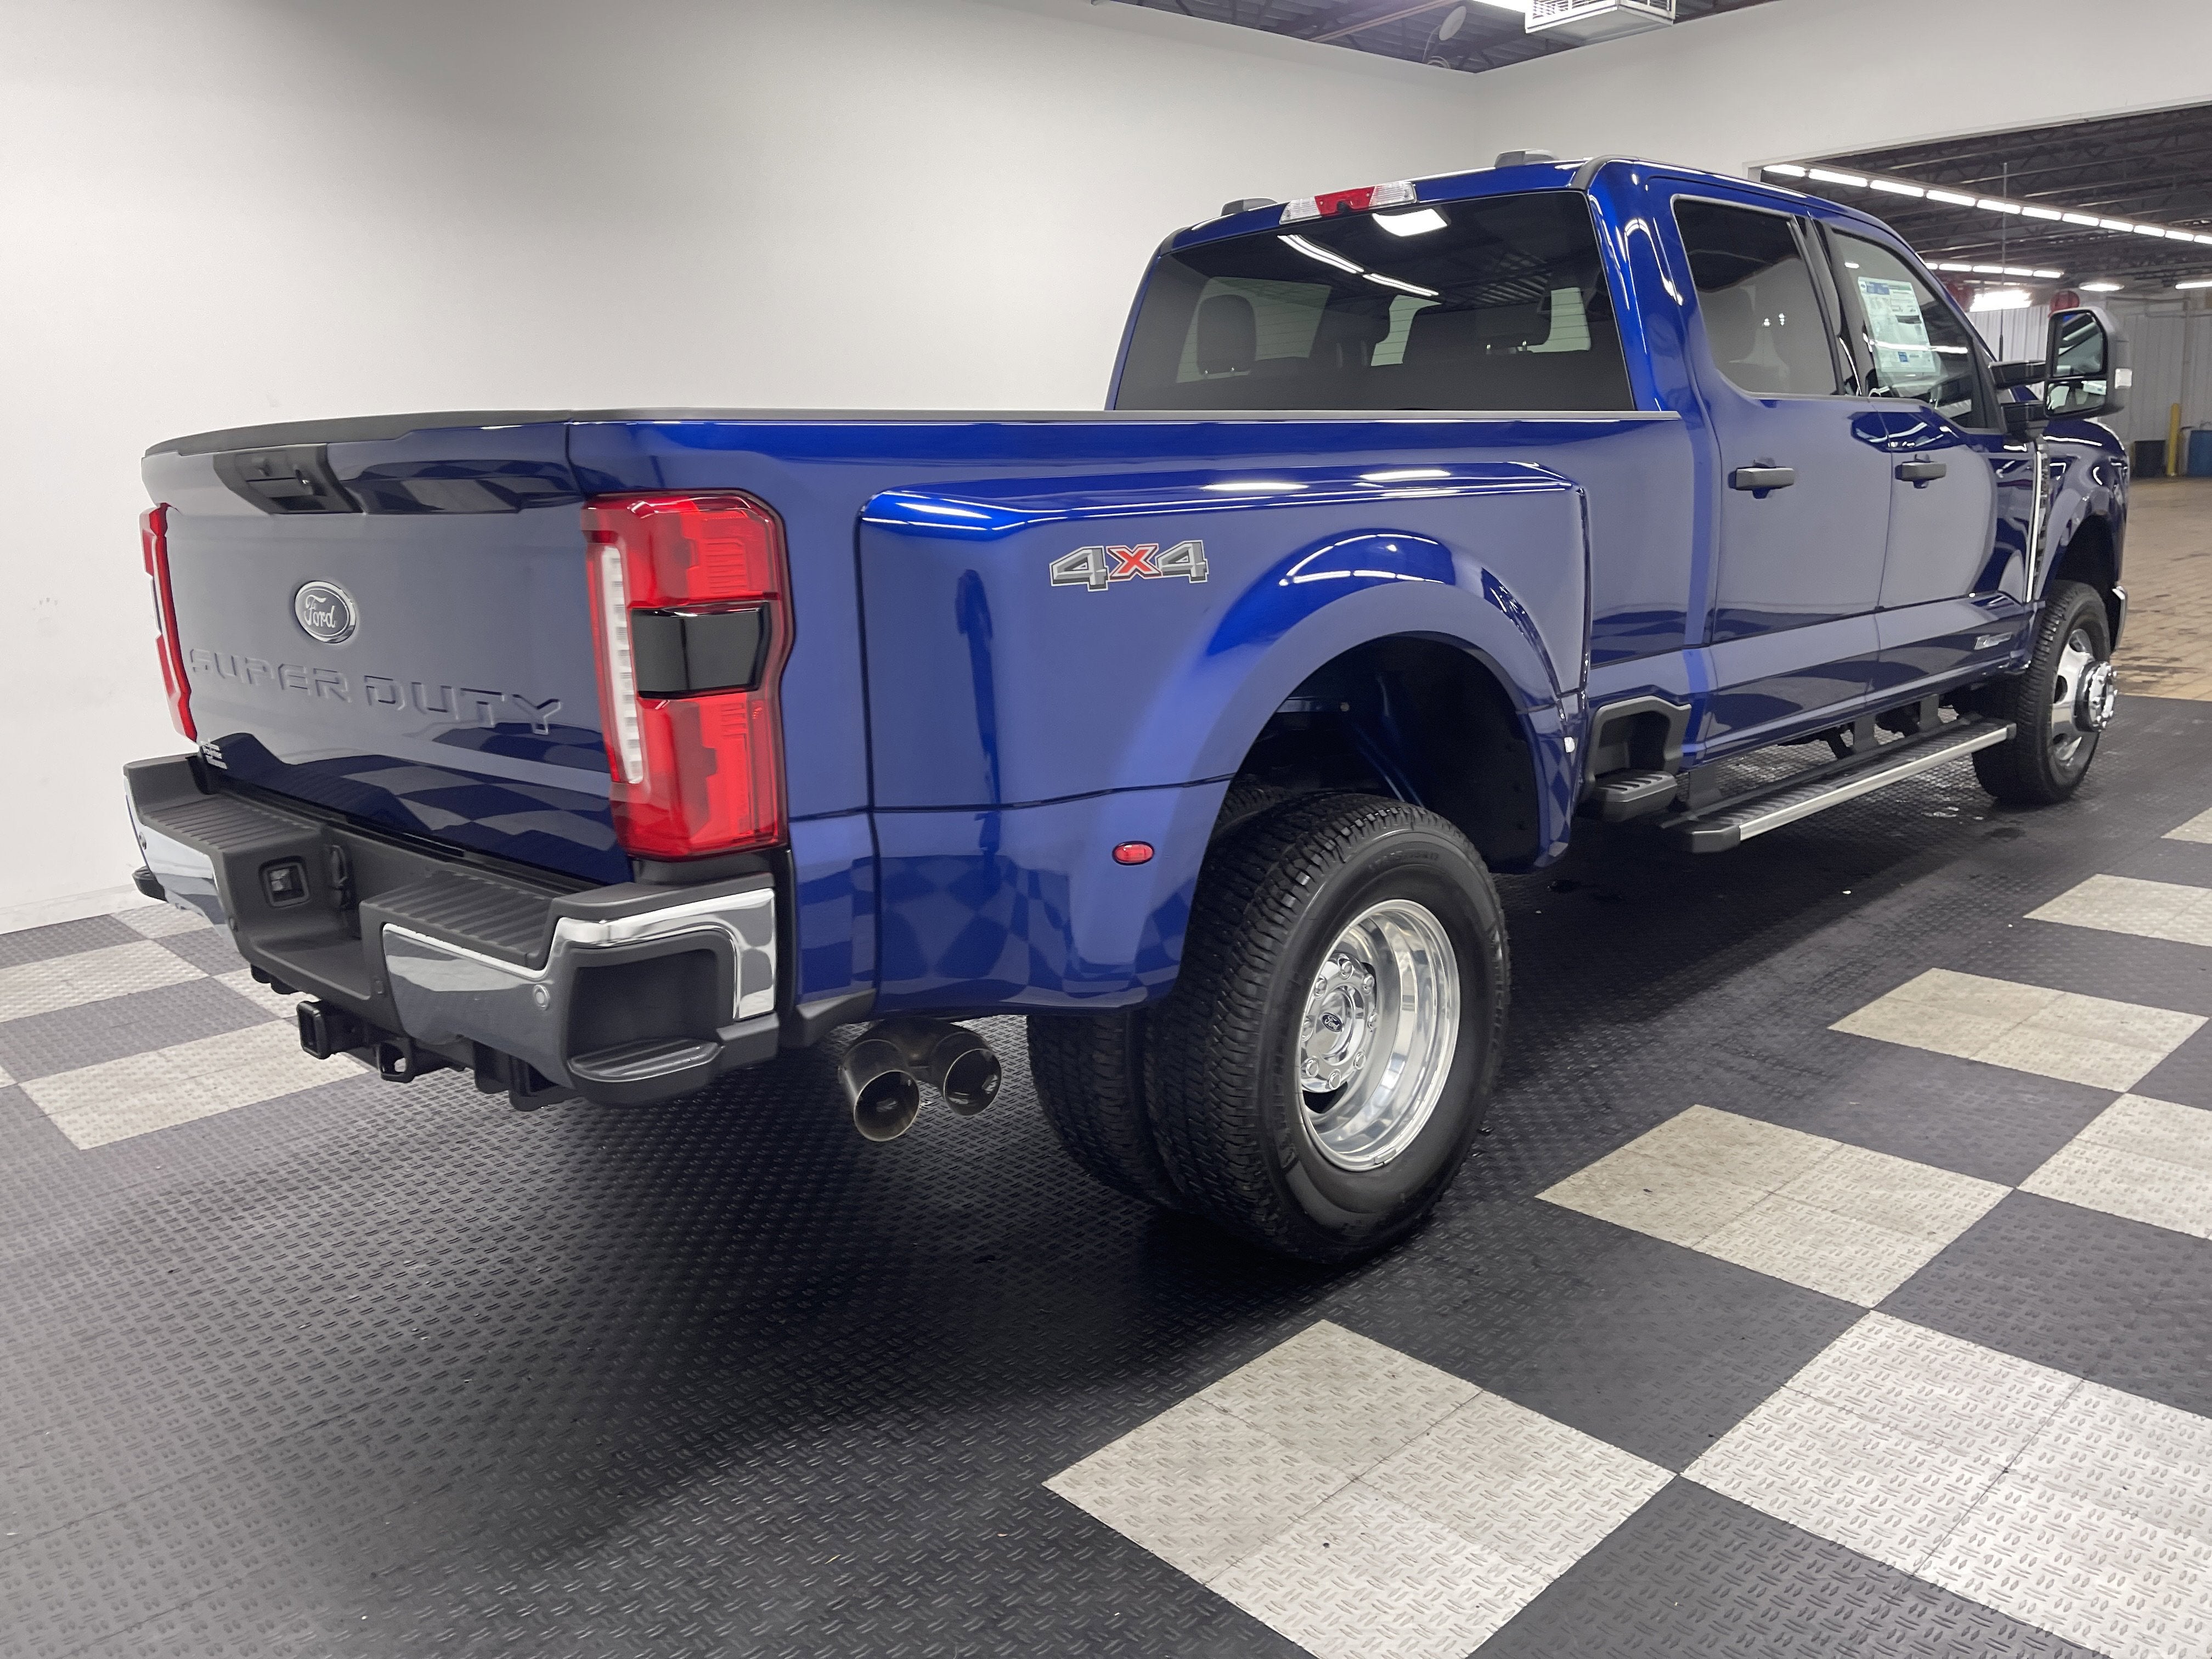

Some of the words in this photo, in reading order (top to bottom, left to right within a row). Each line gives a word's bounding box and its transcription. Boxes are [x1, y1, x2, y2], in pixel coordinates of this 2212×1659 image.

[304, 594, 336, 628] Ford
[189, 648, 352, 703] SUPER
[364, 675, 562, 736] DUTY
[1324, 1015, 1340, 1030] Ford
